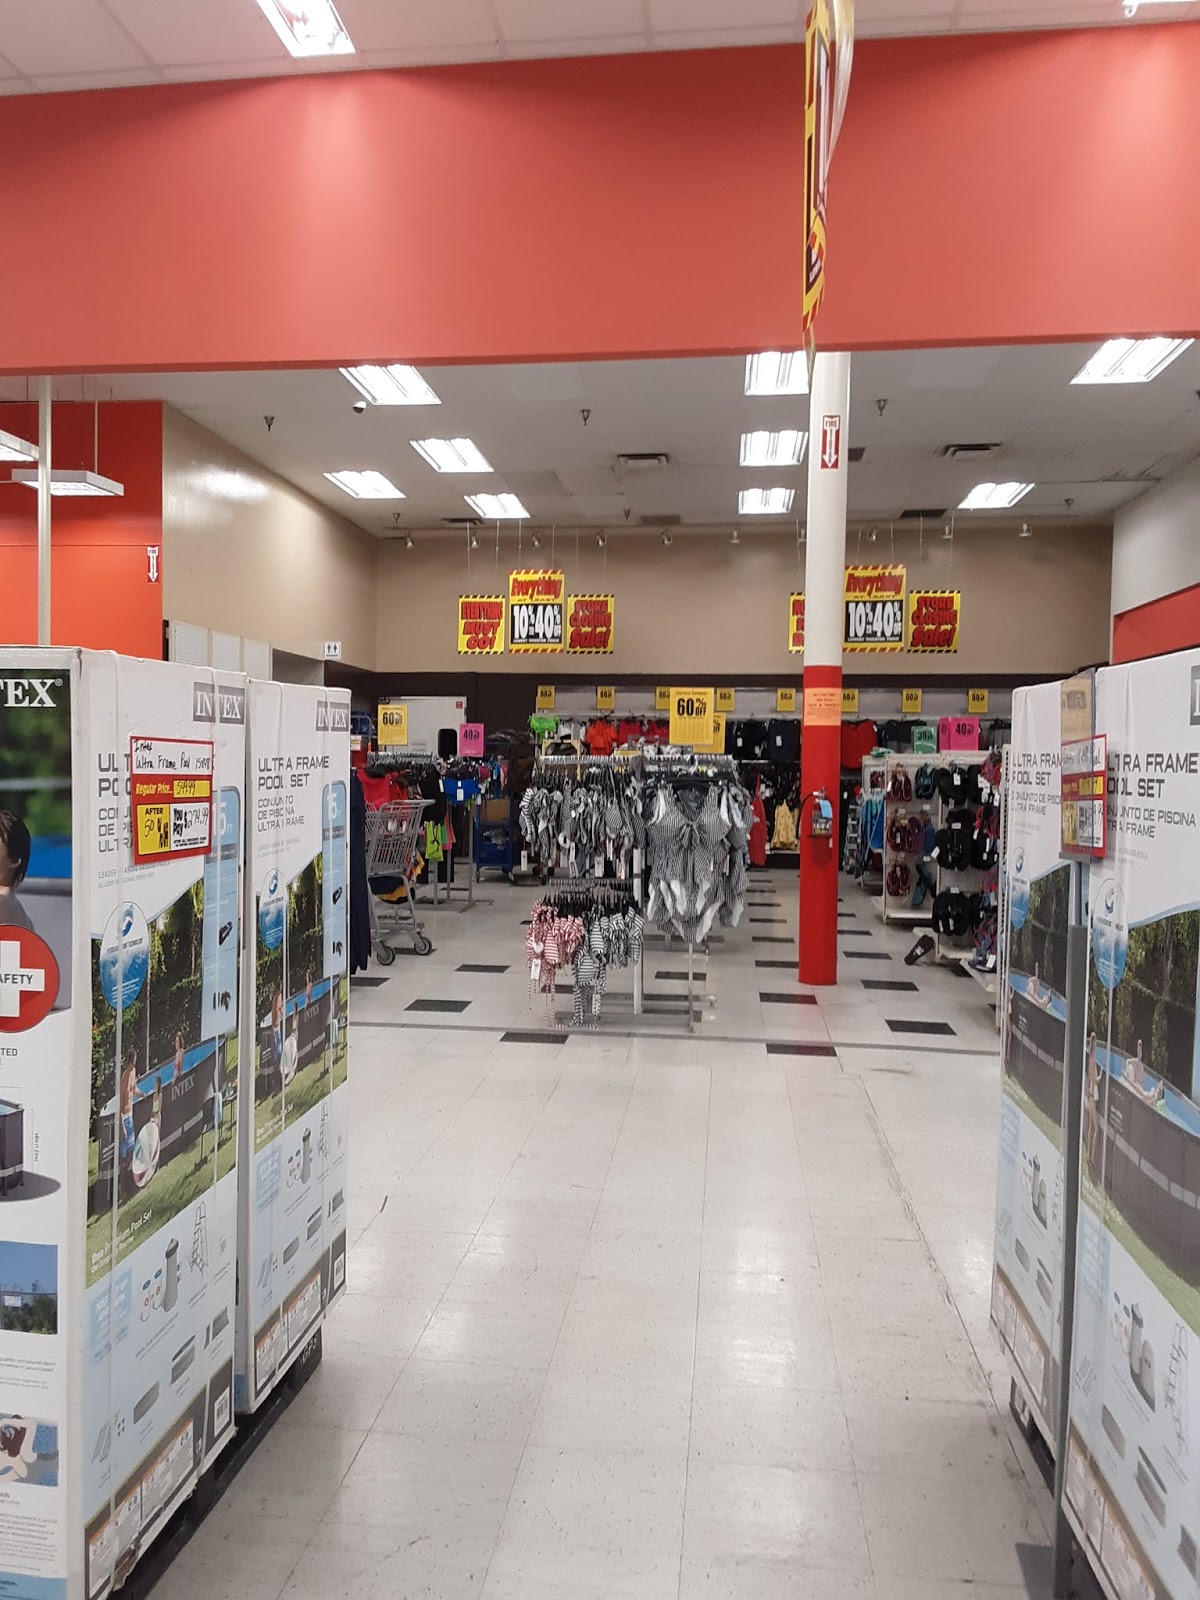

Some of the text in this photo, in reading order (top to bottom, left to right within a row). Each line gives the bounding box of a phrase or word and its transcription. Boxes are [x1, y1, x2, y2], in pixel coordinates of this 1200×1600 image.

[461, 601, 503, 620] EVERYTHING
[916, 596, 954, 610] STORE
[570, 611, 612, 628] CLOSING
[912, 610, 958, 626] CLOSING
[463, 621, 501, 636] MUST
[466, 635, 497, 650] GO!
[258, 755, 330, 772] ULTRA FRAME
[1040, 753, 1062, 768] FRAM
[1106, 753, 1141, 772] LTRA
[1145, 752, 1199, 774] FRAME
[290, 773, 310, 788] SET
[1035, 771, 1051, 786] SET
[1106, 777, 1133, 796] OOL
[1137, 778, 1165, 798] SET
[145, 807, 164, 816] AFTER
[269, 806, 295, 818] PISCNA
[1143, 808, 1155, 821] DE
[1157, 809, 1197, 828] PISCINA
[1125, 822, 1156, 838] FRAME
[171, 1073, 196, 1100] INTEX
